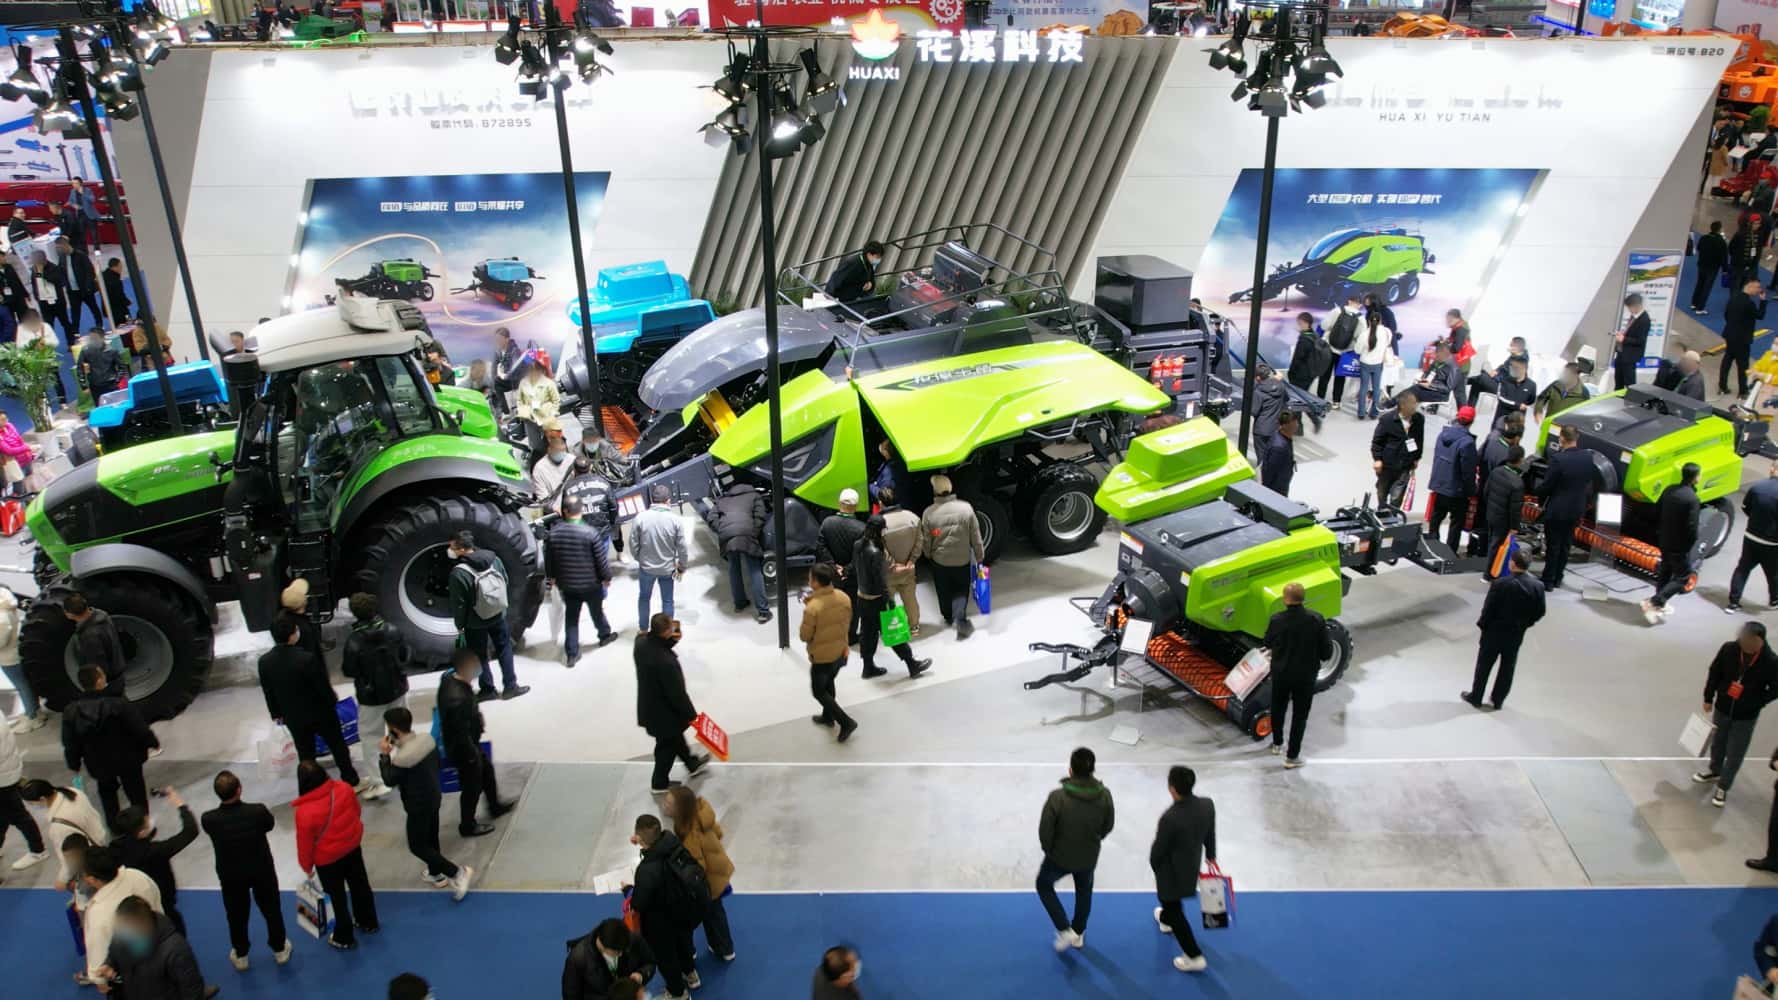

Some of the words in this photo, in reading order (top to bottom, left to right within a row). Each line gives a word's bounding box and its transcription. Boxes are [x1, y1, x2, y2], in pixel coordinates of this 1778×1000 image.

[916, 29, 1084, 63] 花溪科技
[848, 67, 900, 81] HUAXI
[1379, 112, 1406, 123] HUA
[1413, 112, 1427, 123] XI
[1436, 112, 1453, 123] YU
[1460, 112, 1491, 123] TIAN
